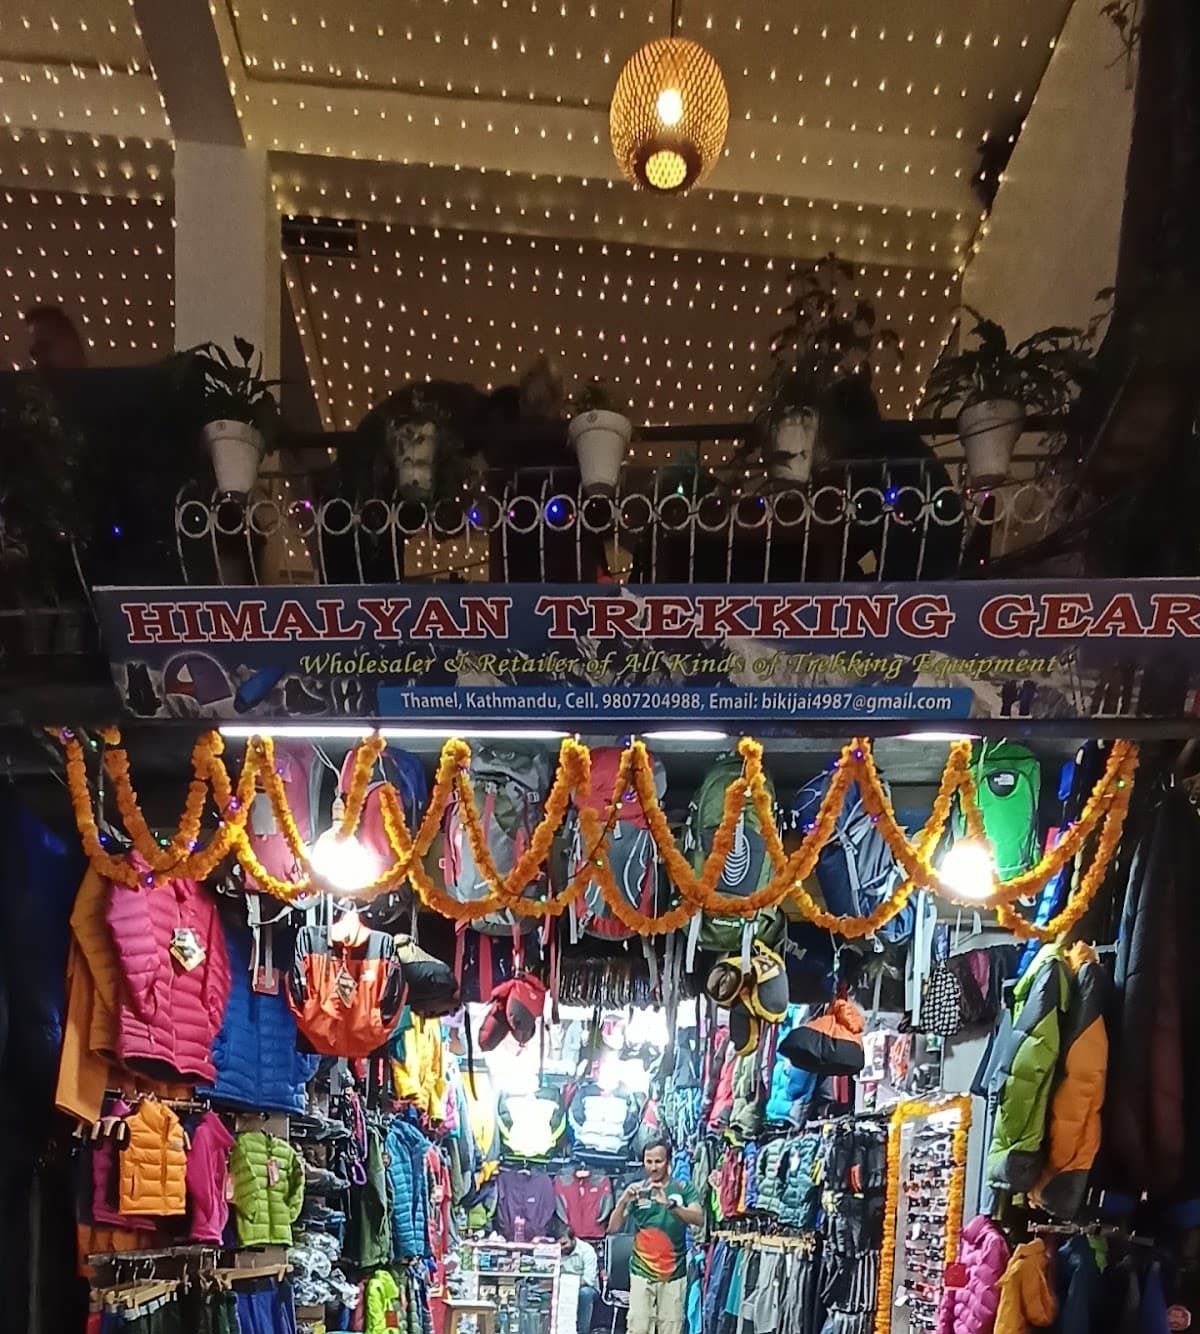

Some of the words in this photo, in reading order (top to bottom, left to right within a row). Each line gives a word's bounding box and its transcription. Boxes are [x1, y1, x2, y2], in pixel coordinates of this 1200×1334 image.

[120, 597, 513, 643] HIMALYAN
[535, 594, 956, 640] TREKKING
[979, 593, 1200, 639] GEAR
[299, 650, 434, 675] Wholesaler
[443, 653, 466, 673] &
[478, 651, 581, 676] Retailer
[585, 650, 617, 680] of
[618, 650, 662, 676] All
[667, 650, 746, 676] Kinds
[751, 650, 784, 681] of
[789, 649, 904, 681] Trekking
[911, 652, 1057, 681] Equipment
[400, 692, 462, 711] Thamel,
[466, 692, 561, 710] Kathmandu,
[565, 692, 599, 710] Cell.
[602, 692, 704, 711] 9807204988,
[709, 692, 758, 710] Email:
[761, 692, 952, 714] bikijai4987@gmail.com
